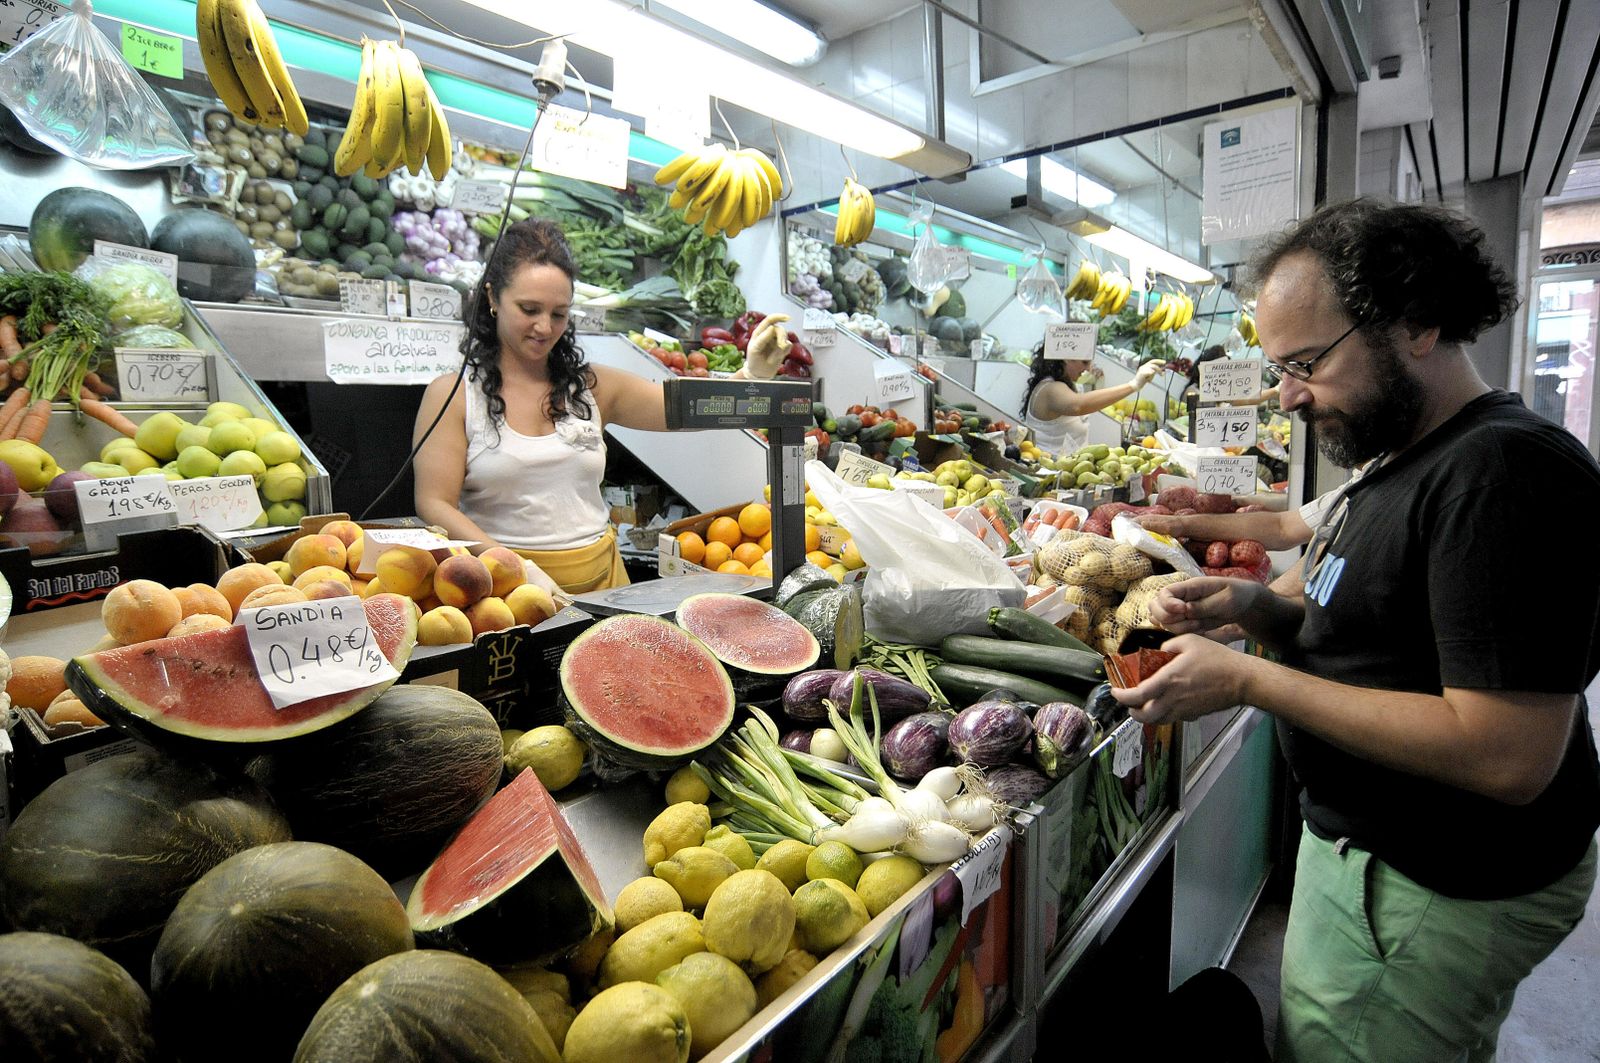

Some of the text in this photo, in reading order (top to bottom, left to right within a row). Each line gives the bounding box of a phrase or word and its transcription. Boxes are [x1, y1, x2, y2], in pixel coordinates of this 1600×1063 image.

[88, 486, 130, 498] GALA
[27, 578, 52, 599] Sol
[52, 574, 75, 596] del
